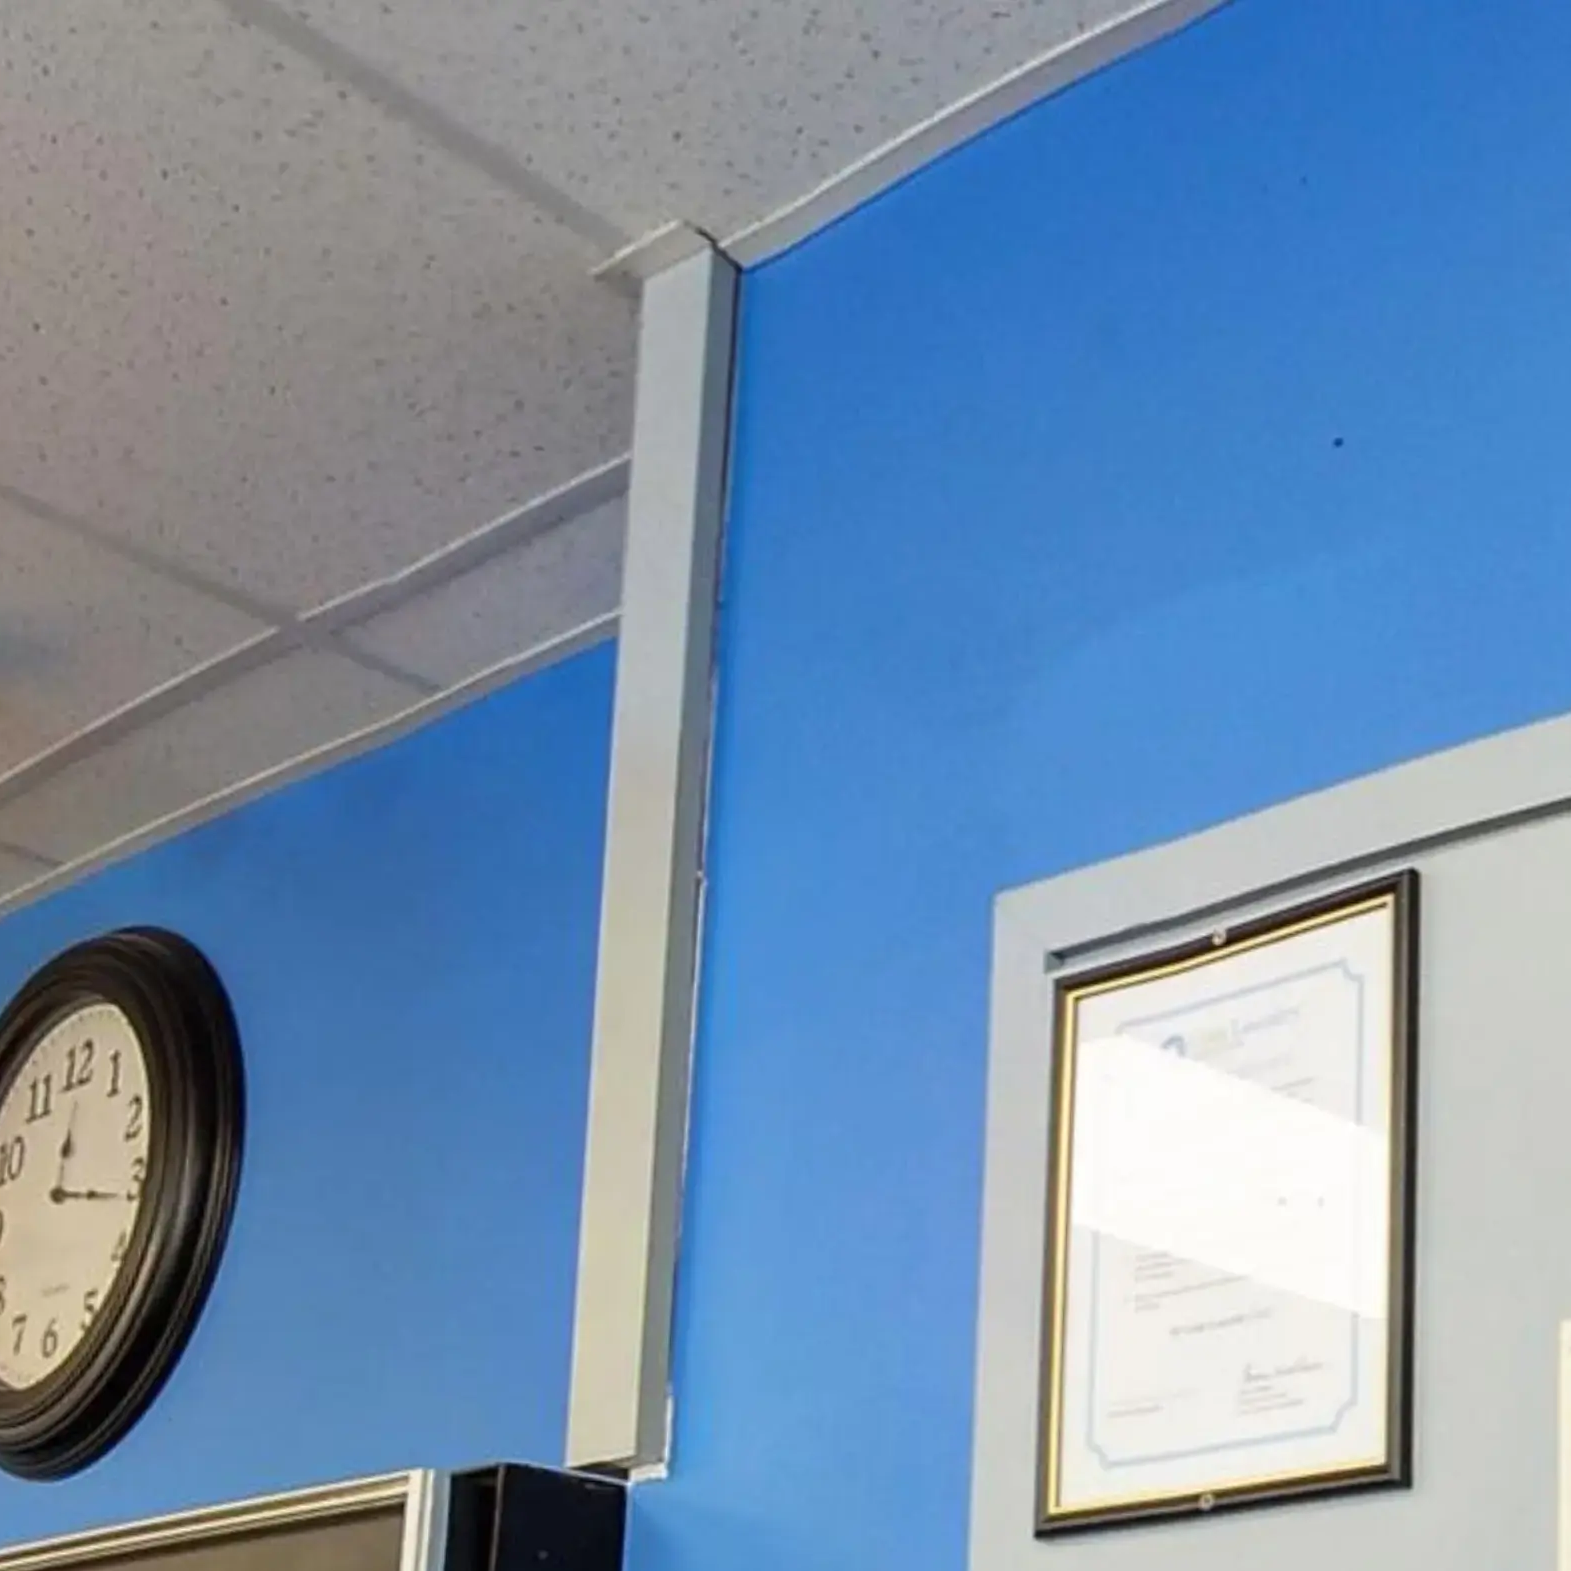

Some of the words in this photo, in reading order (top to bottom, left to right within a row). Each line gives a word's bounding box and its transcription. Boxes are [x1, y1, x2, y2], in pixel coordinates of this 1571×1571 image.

[61, 1038, 93, 1093] 12
[106, 1049, 121, 1097] 1
[26, 1073, 52, 1124] 11
[124, 1094, 142, 1141] 2
[126, 1157, 144, 1201] 3
[80, 1288, 98, 1331] 5
[11, 1314, 27, 1356] 7
[40, 1318, 58, 1358] 6
